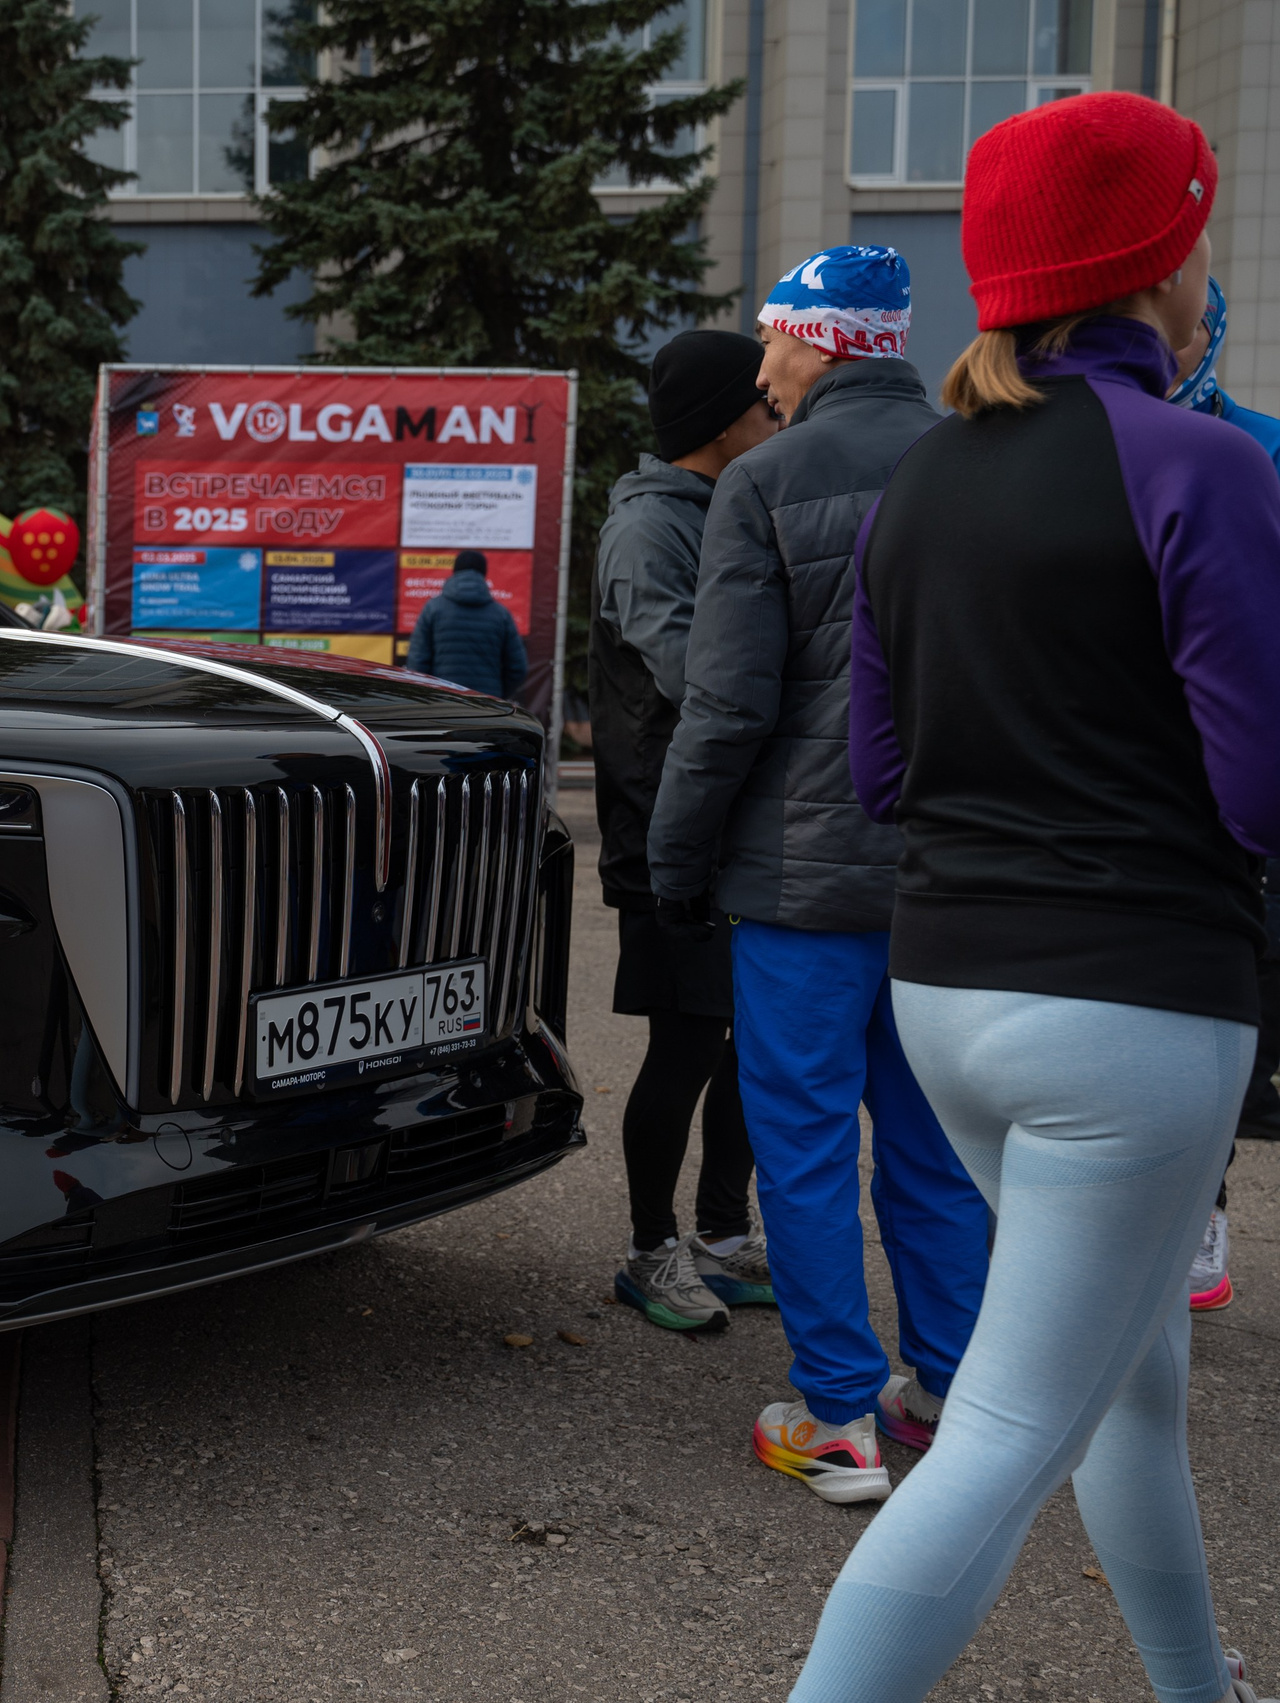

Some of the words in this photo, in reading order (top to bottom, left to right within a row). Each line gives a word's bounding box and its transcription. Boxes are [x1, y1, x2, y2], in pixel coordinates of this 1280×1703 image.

[144, 472, 386, 500] ВСТРЕЧАЕМСЯ
[144, 505, 166, 530] В
[173, 507, 249, 532] 2025
[256, 507, 344, 537] ГОДУ
[271, 573, 335, 584] САМАРСКИЙ
[271, 583, 347, 594] КОСМИЧЕСКИЙ
[271, 594, 351, 605] ПОЛУМАРАФОН
[268, 991, 418, 1068] М875КУ
[426, 970, 476, 1019] 763
[438, 1013, 462, 1036] RUS
[451, 1039, 476, 1051] 331-73-33
[271, 1071, 326, 1090] САМАРА-МОТОРС
